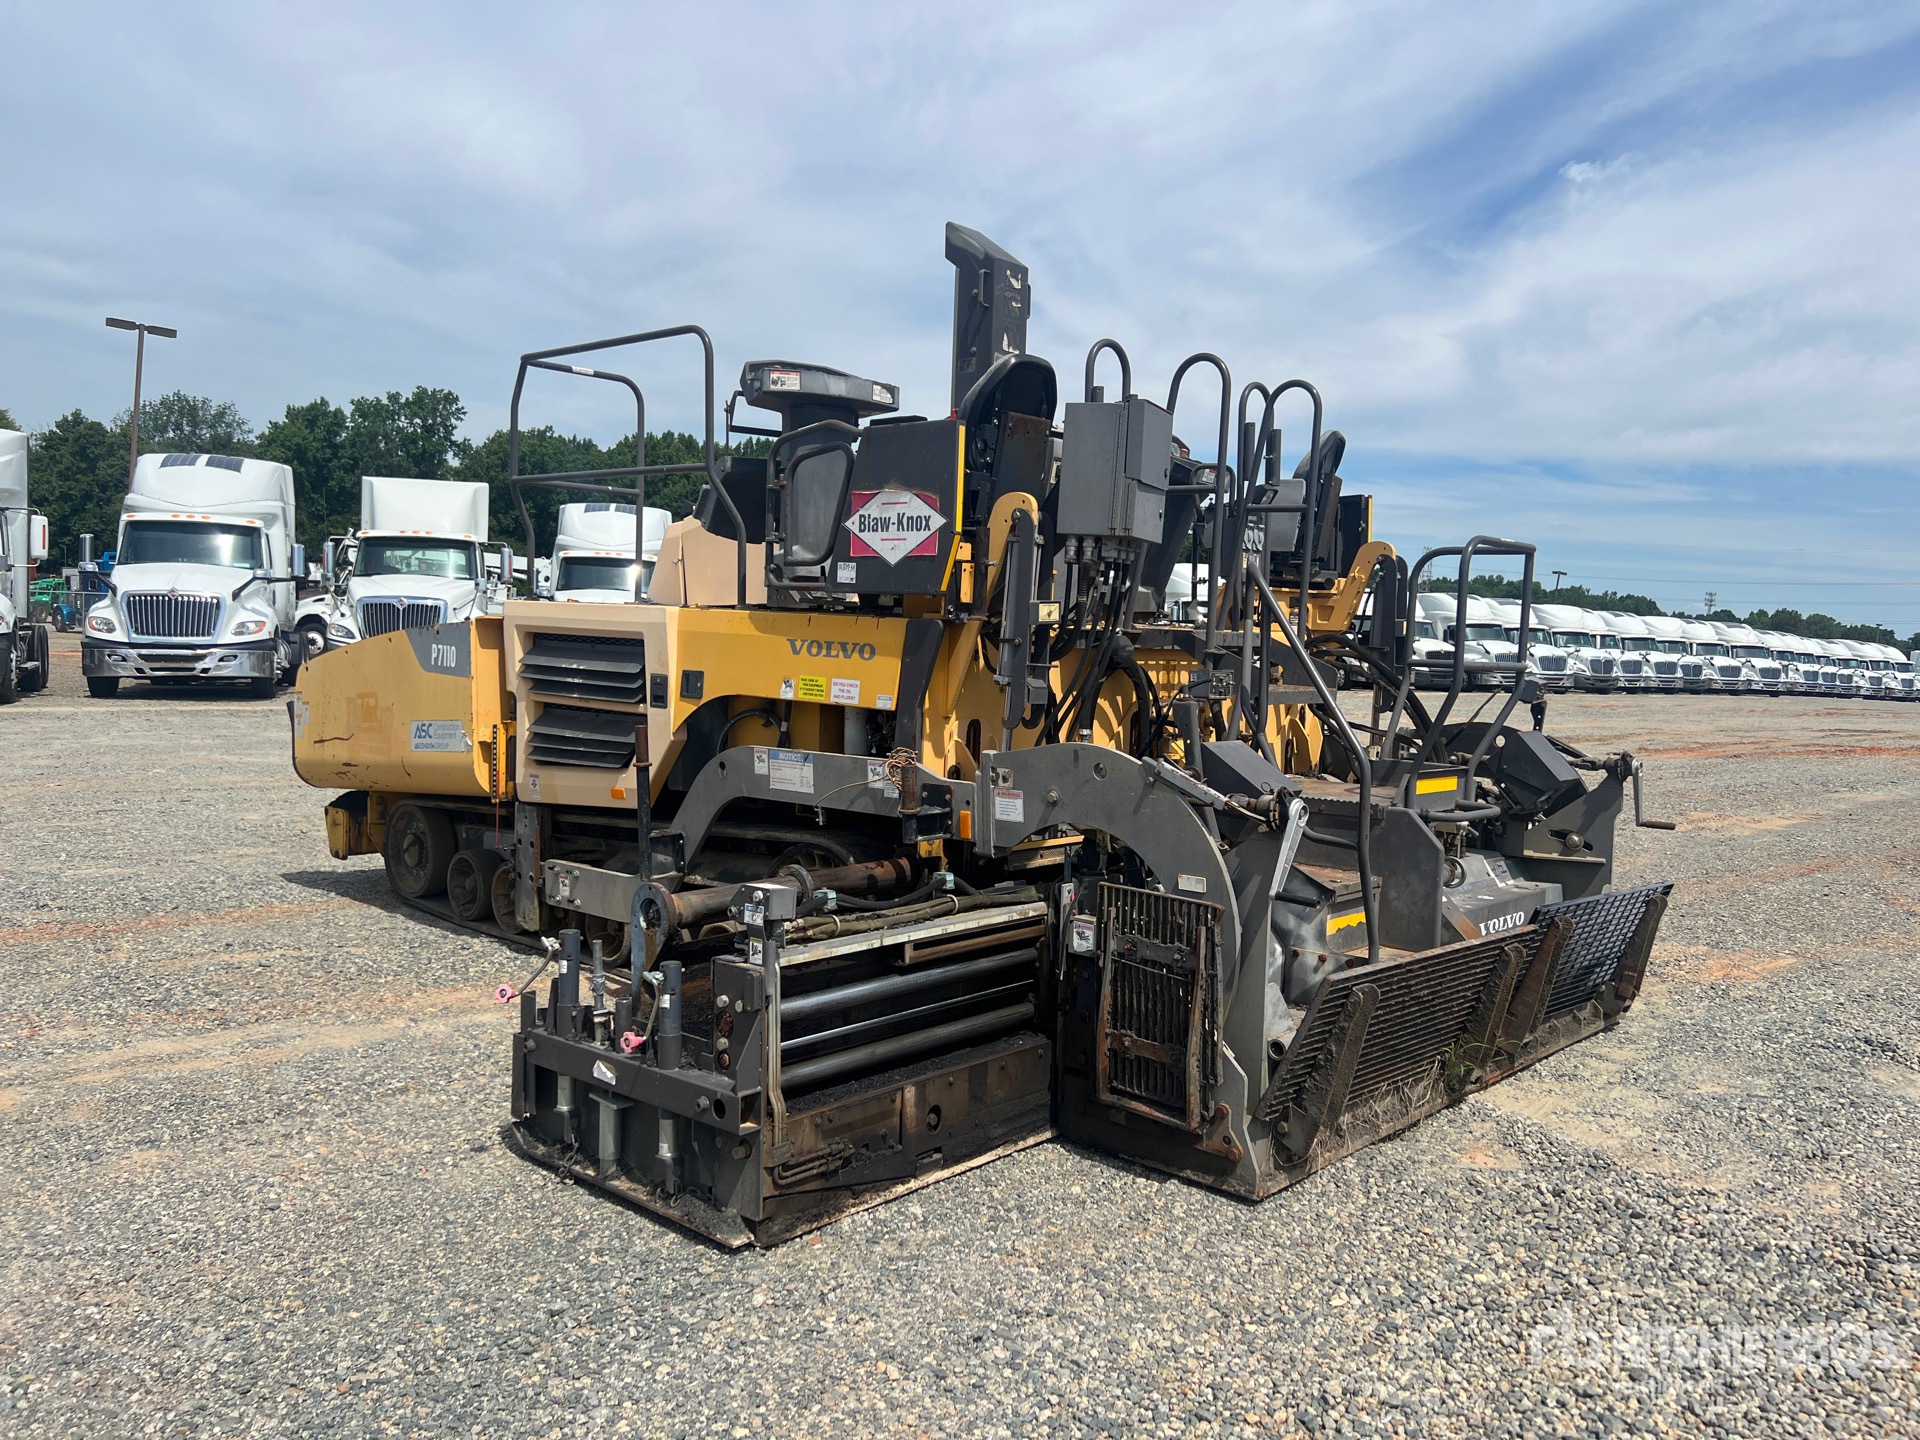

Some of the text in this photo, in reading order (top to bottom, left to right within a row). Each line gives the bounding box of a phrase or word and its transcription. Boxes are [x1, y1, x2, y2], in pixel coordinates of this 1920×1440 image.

[858, 512, 932, 533] Blaw-Knox
[431, 643, 457, 668] P7110
[787, 638, 877, 661] VOLVO
[413, 722, 433, 739] ASC
[433, 731, 457, 740] Equipment
[779, 752, 802, 761] NOTICE
[1479, 911, 1525, 936] VOLVO
